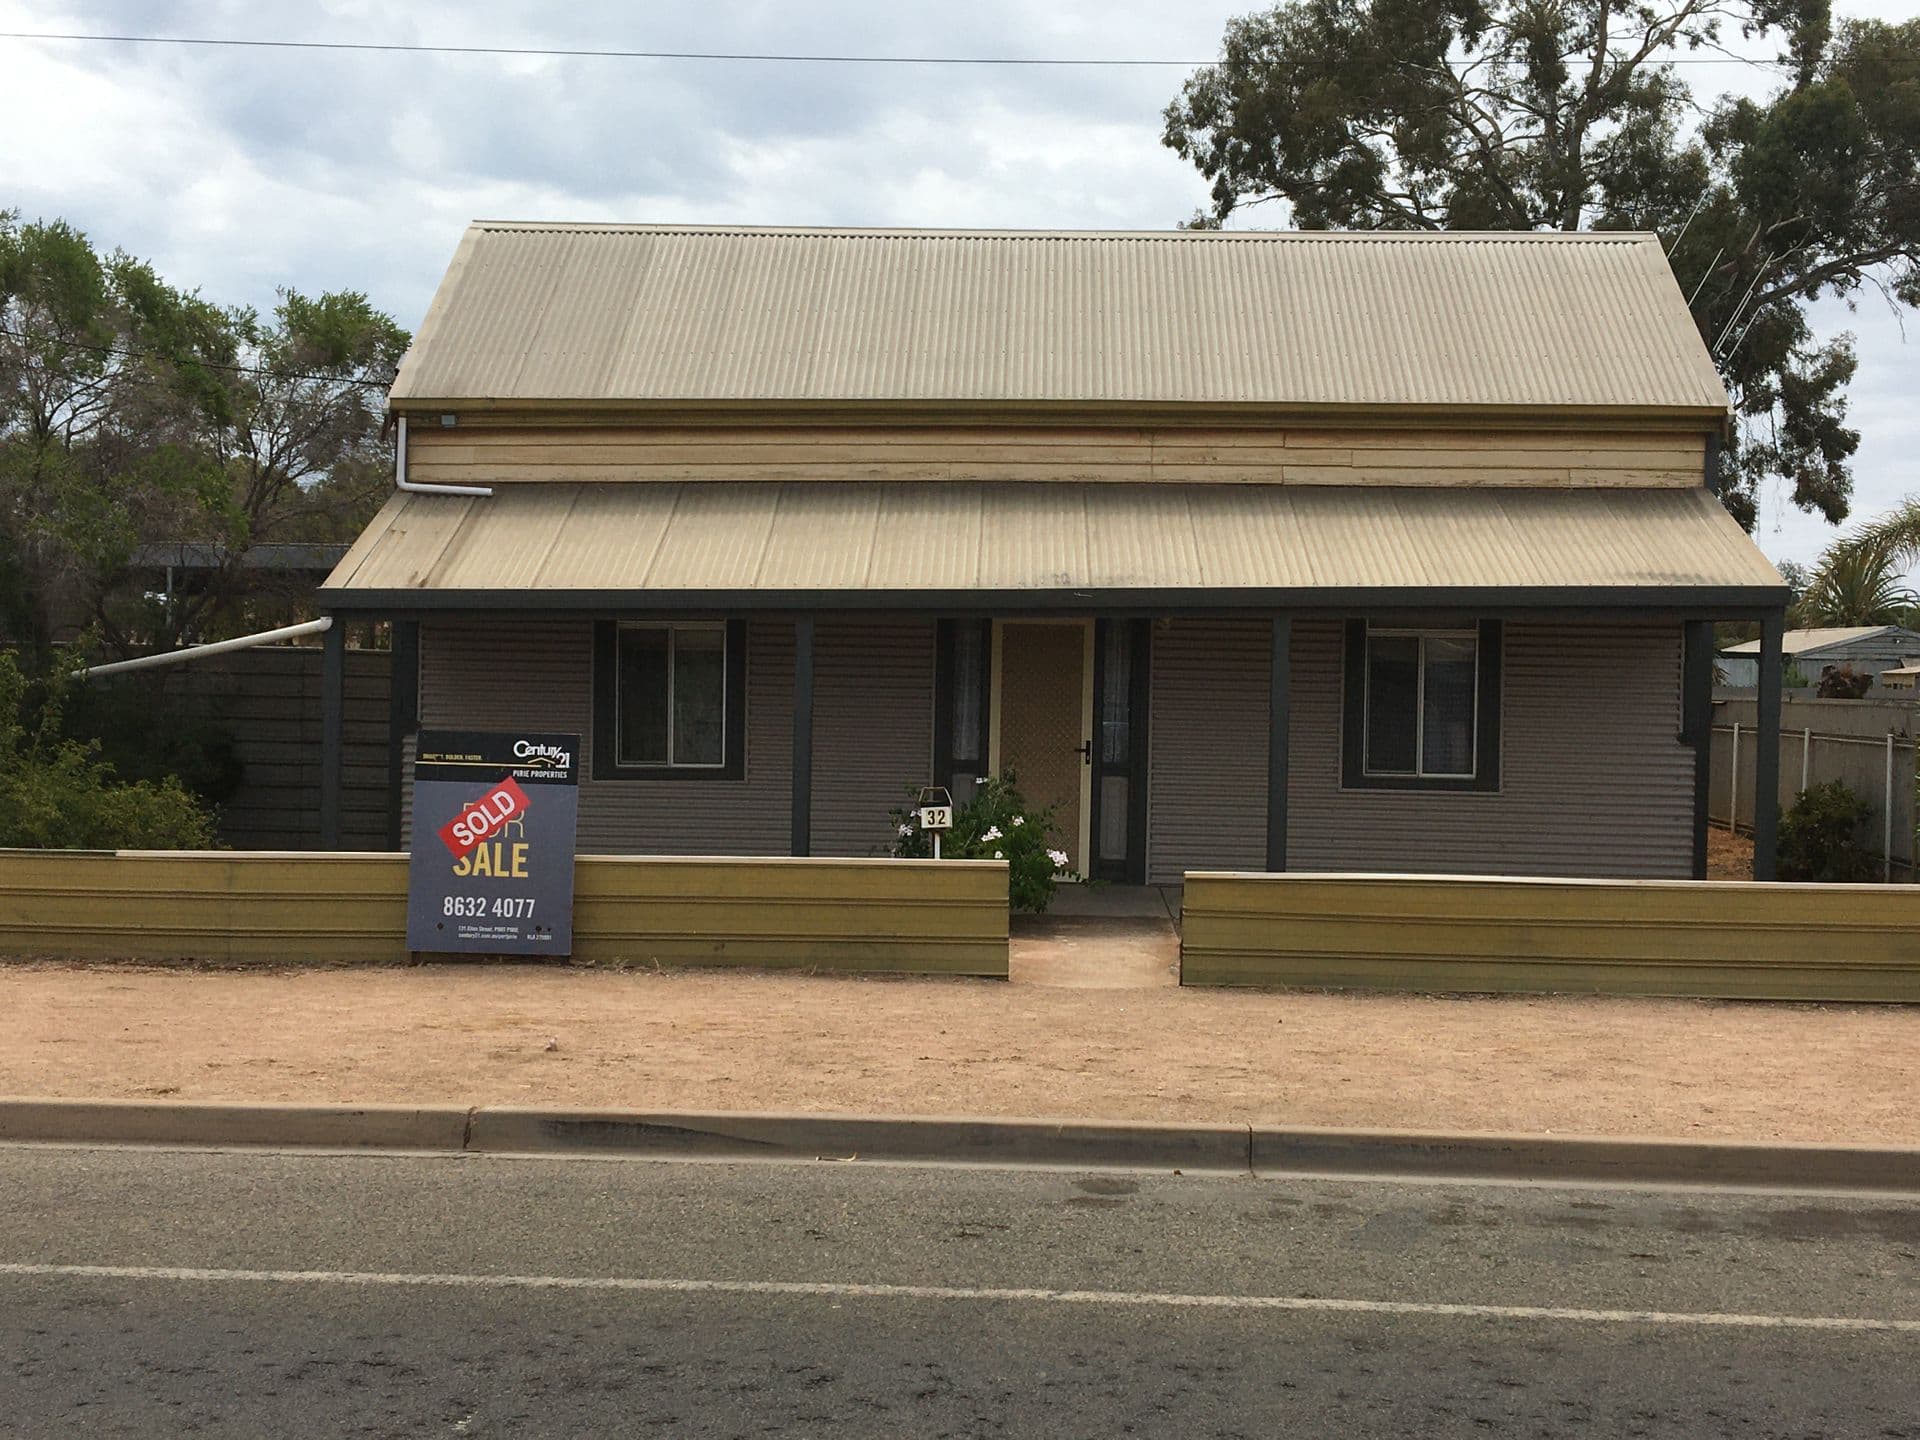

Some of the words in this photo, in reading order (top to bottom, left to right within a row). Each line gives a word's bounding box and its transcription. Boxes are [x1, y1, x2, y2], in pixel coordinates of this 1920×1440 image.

[513, 740, 562, 759] Century
[555, 752, 570, 768] 21
[512, 769, 530, 778] PIRIE
[530, 770, 568, 779] PROPERTIES
[452, 790, 515, 846] SOLD
[927, 810, 945, 825] 32
[443, 896, 487, 917] 8632
[491, 898, 535, 918] 4077
